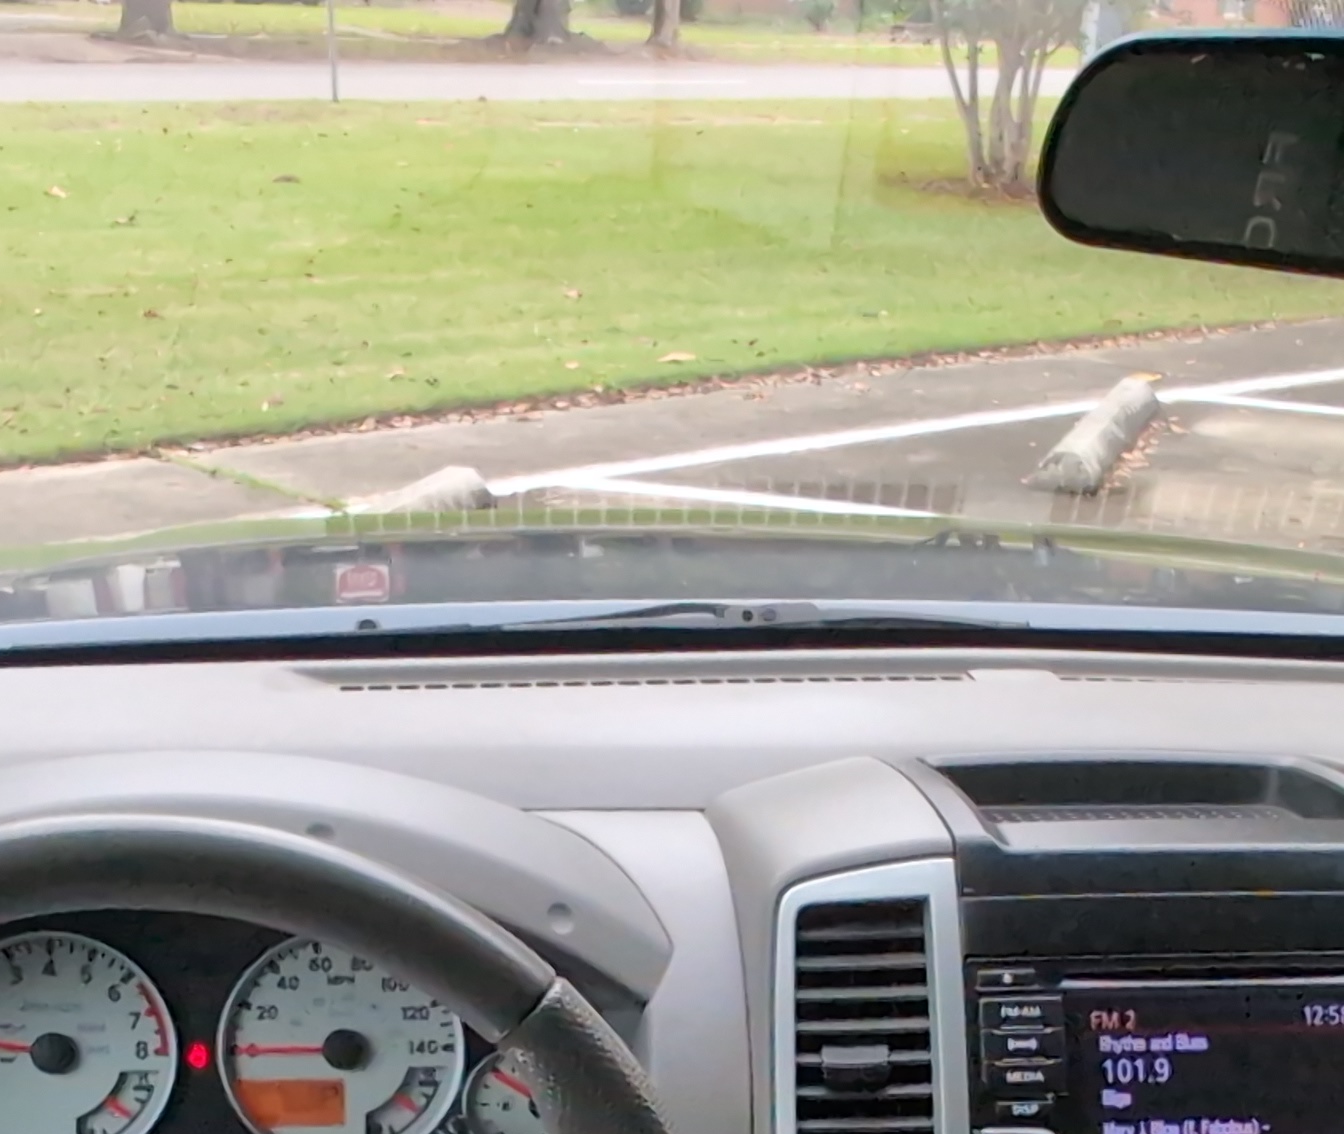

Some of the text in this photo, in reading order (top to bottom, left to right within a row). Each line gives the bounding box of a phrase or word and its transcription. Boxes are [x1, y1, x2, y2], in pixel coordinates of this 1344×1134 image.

[276, 976, 299, 990] 40
[108, 985, 121, 1002] 6
[129, 1012, 141, 1030] 7
[256, 1006, 279, 1020] 20
[401, 1006, 430, 1020] 120
[1090, 1009, 1137, 1030] FM 2
[136, 1041, 149, 1060] 8
[409, 1040, 438, 1054] 140
[1101, 1057, 1172, 1084] 101.9
